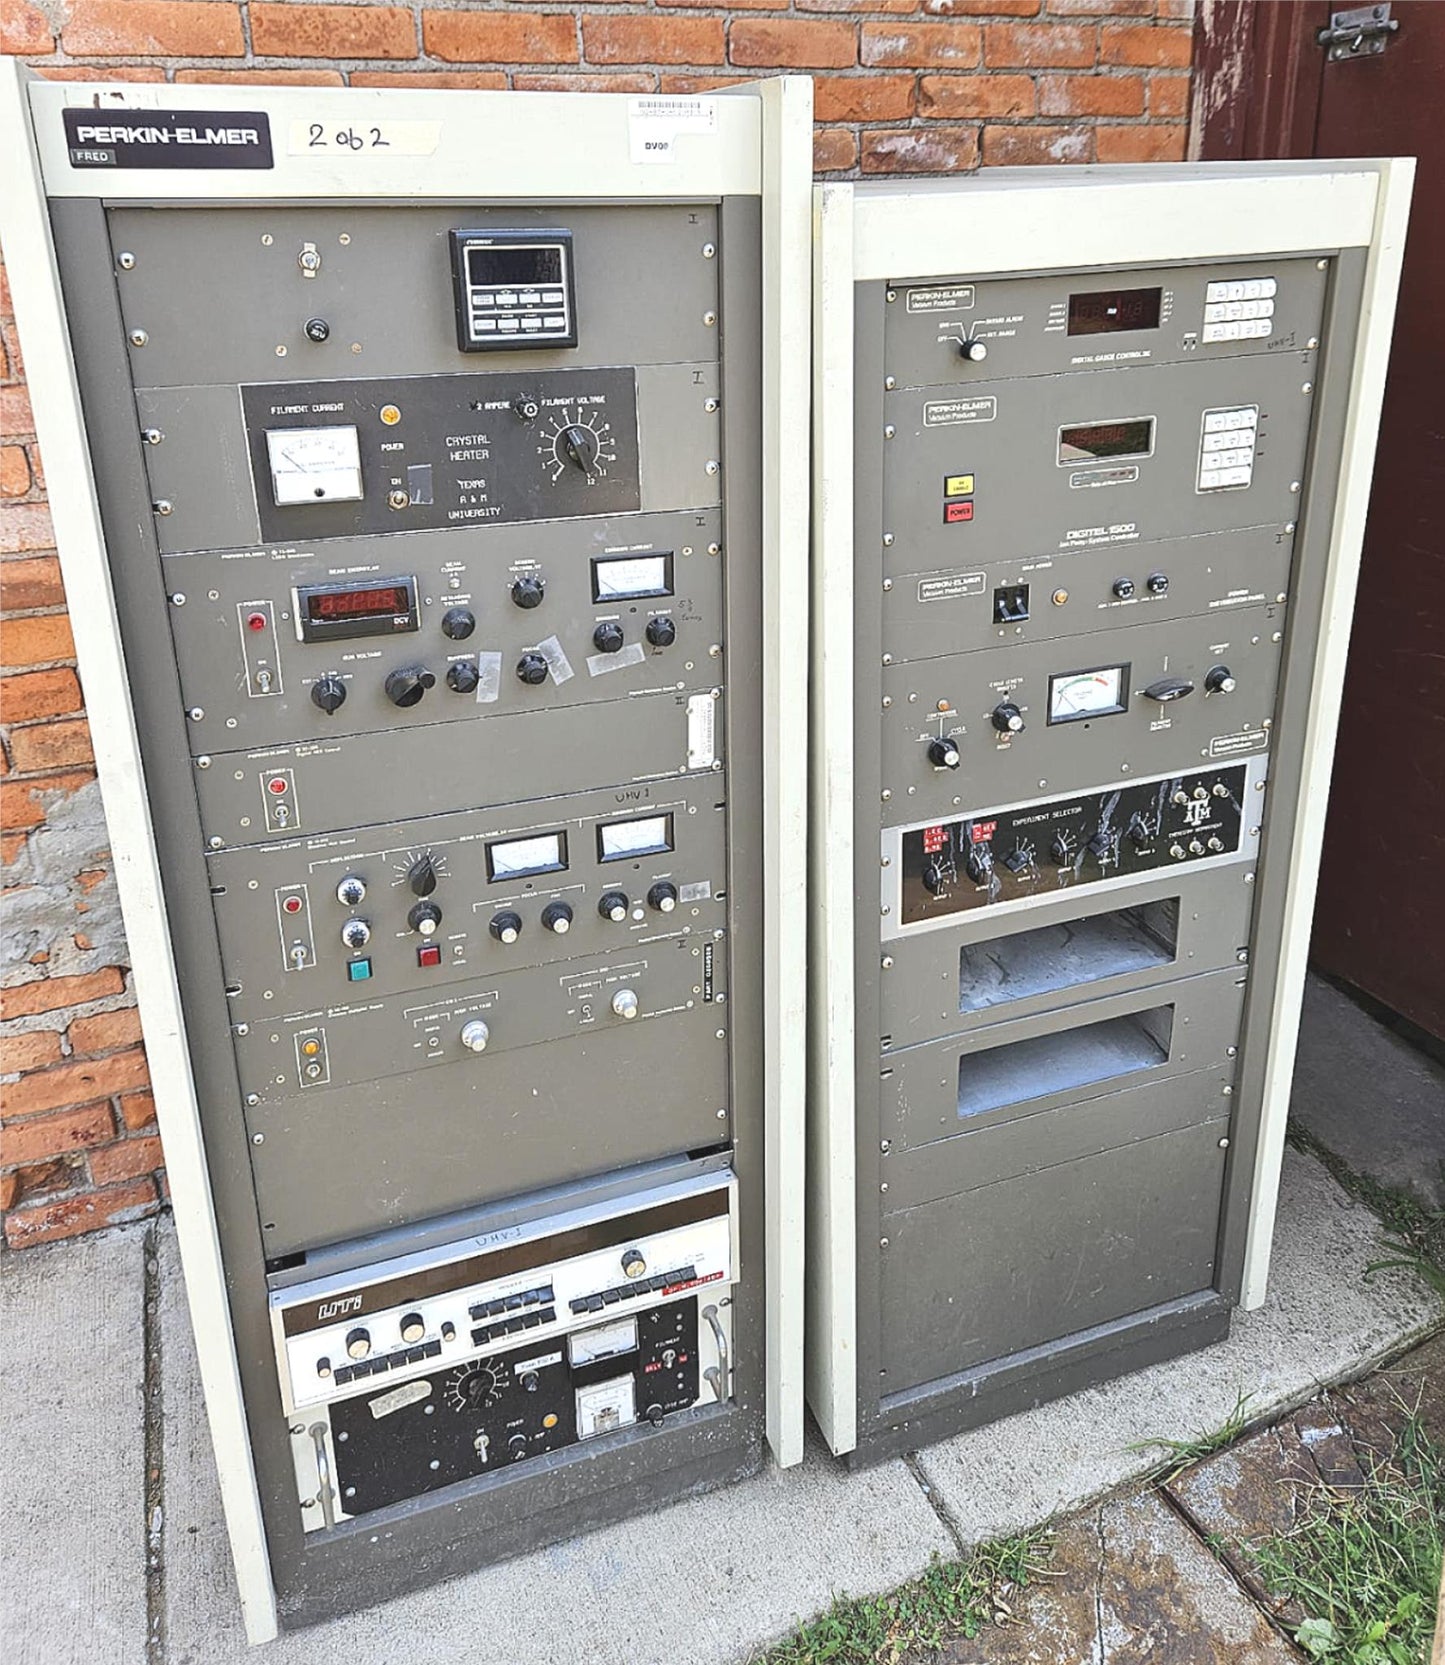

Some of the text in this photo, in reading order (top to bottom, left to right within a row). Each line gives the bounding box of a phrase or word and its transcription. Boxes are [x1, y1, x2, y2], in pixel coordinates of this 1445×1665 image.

[77, 126, 260, 146] PERKIN-ELMER
[309, 123, 328, 147] 2
[370, 128, 391, 147] 2
[76, 151, 109, 163] FRED
[271, 402, 345, 416] FILAMENT CURRENT
[541, 397, 575, 408] FILAMENT
[381, 441, 405, 452] POWER
[446, 435, 492, 448] CRYSTAL
[450, 448, 490, 461] HEATER
[458, 478, 486, 490] TEXAS
[448, 506, 501, 520] UNIVERSITY
[1109, 522, 1137, 535] 1500
[394, 615, 410, 625] DCV
[1012, 806, 1083, 827] EXPERIMENT SELECTOR
